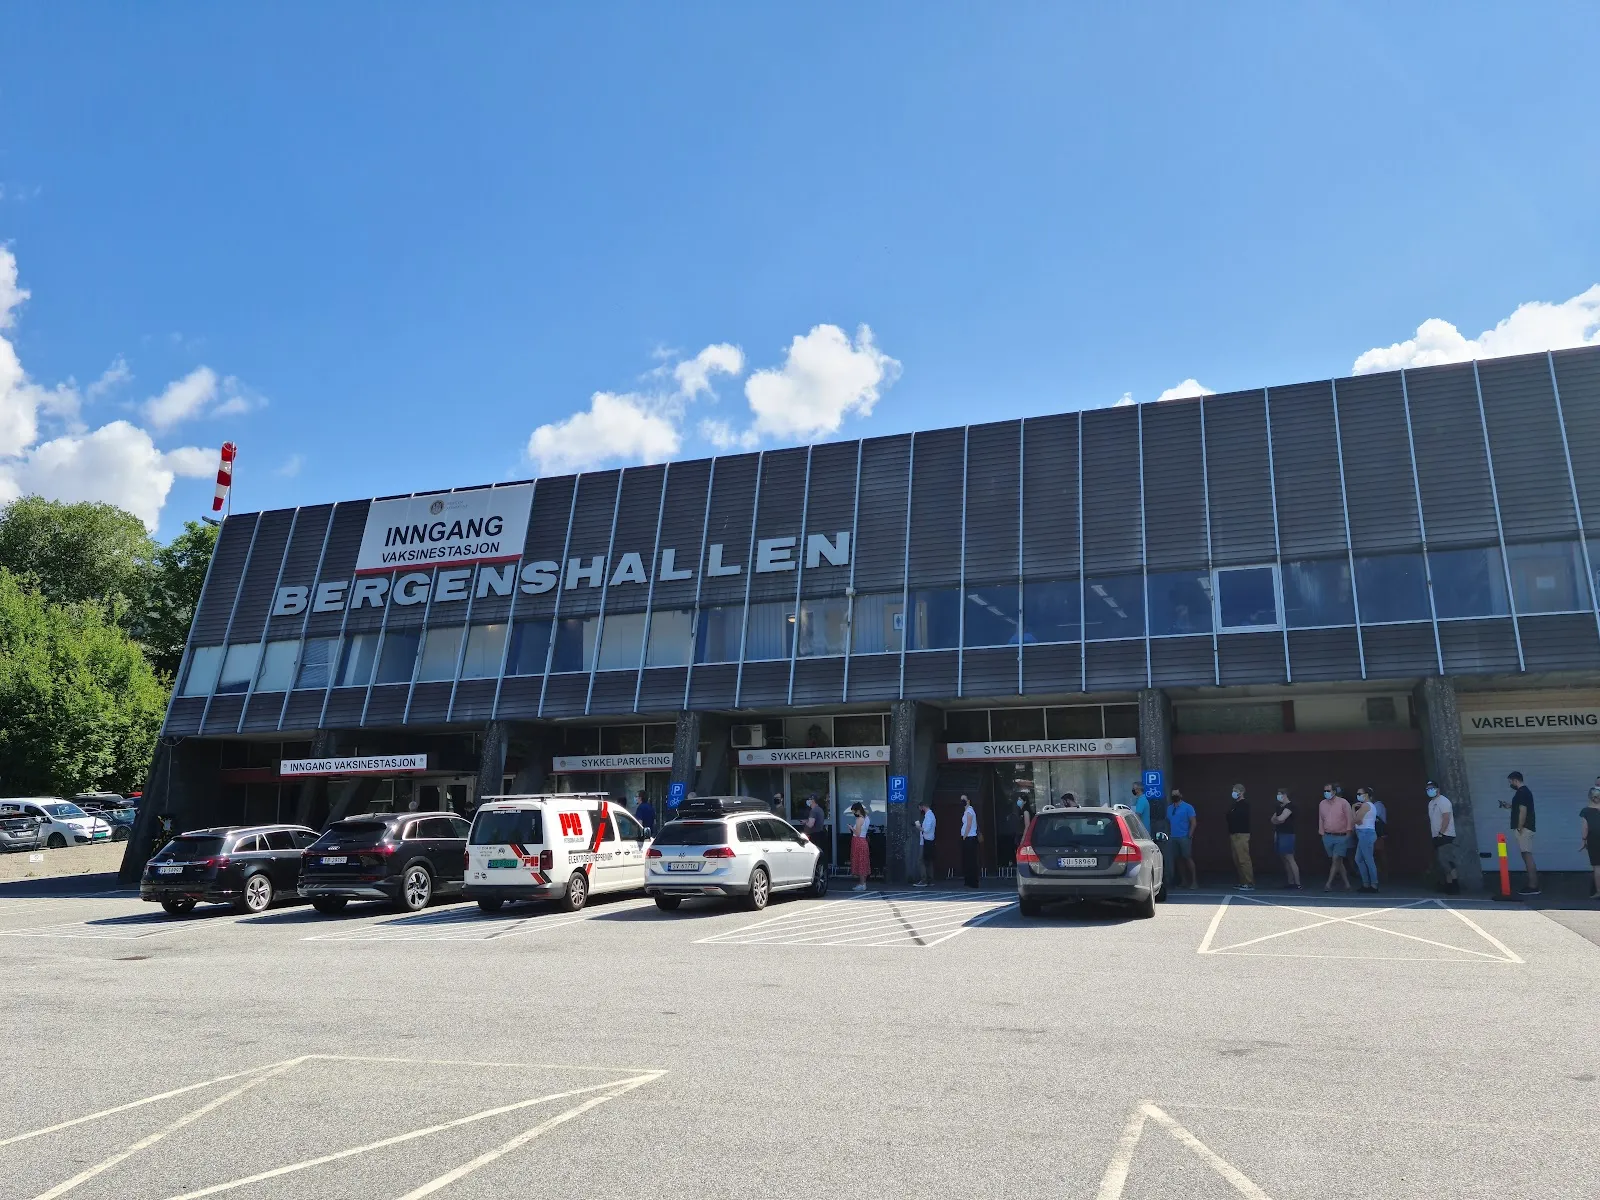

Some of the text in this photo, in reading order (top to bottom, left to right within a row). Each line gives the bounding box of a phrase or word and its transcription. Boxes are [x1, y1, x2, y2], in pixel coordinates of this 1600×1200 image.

[384, 515, 503, 546] INNGANG
[382, 541, 500, 563] VAKSINESTASJON
[272, 531, 850, 616] BERGENSHALLEN
[1472, 714, 1598, 728] VARELEVERING
[771, 750, 870, 761] SYKKELPARKERING
[983, 742, 1097, 755] SYKKELPARKERING
[290, 758, 416, 772] INNGANG VAKSINESTASJON
[581, 756, 670, 767] SYKKELPARKERING
